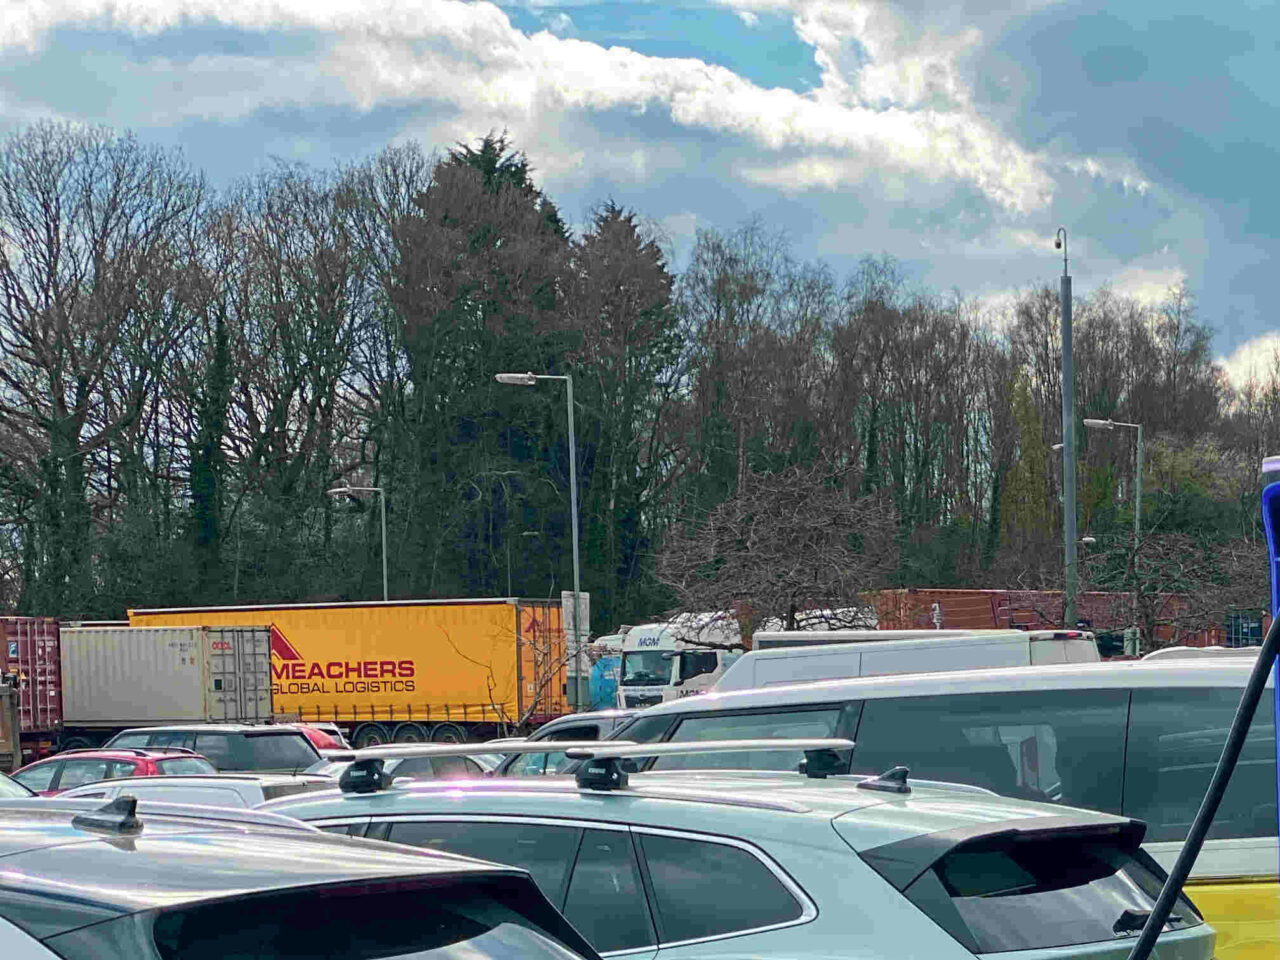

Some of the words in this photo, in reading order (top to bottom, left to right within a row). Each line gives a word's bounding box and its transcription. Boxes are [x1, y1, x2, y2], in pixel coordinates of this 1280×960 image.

[637, 636, 660, 647] MGM
[272, 660, 416, 680] MEACHERS
[272, 682, 330, 695] GLOBAL
[335, 680, 416, 693] LOGISTICS
